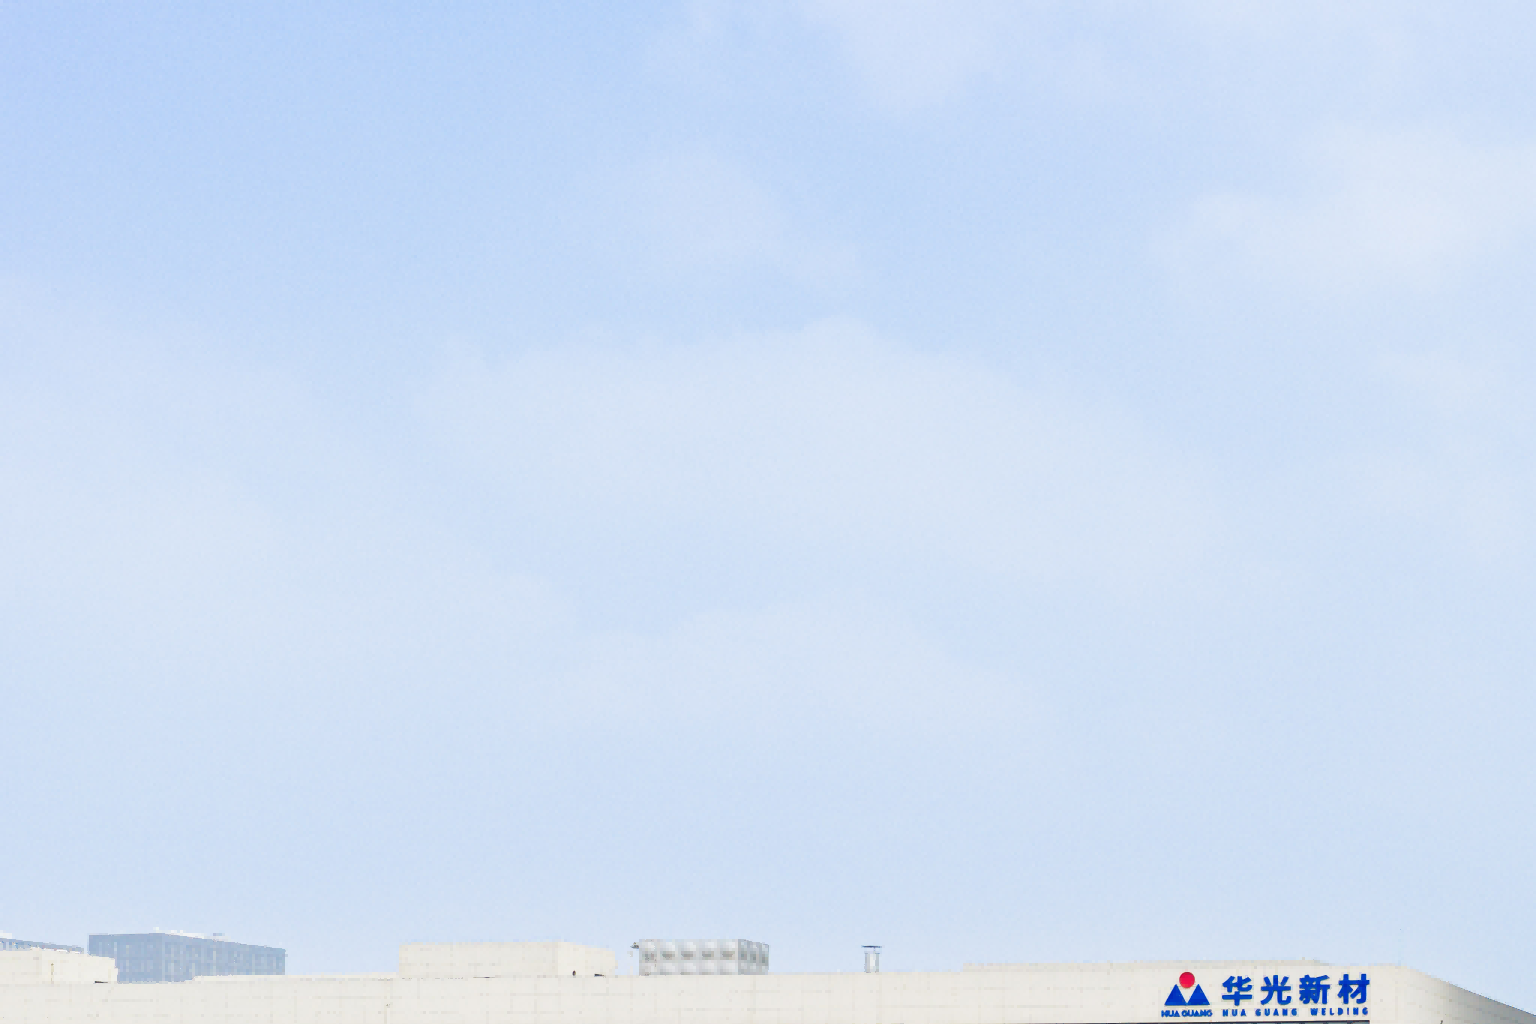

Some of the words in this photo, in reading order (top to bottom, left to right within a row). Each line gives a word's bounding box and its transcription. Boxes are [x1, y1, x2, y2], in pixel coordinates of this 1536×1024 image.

[1221, 973, 1370, 1006] 华光新材
[1222, 1008, 1247, 1017] HUA
[1255, 1008, 1298, 1017] GUANG
[1310, 1007, 1369, 1016] WELDING
